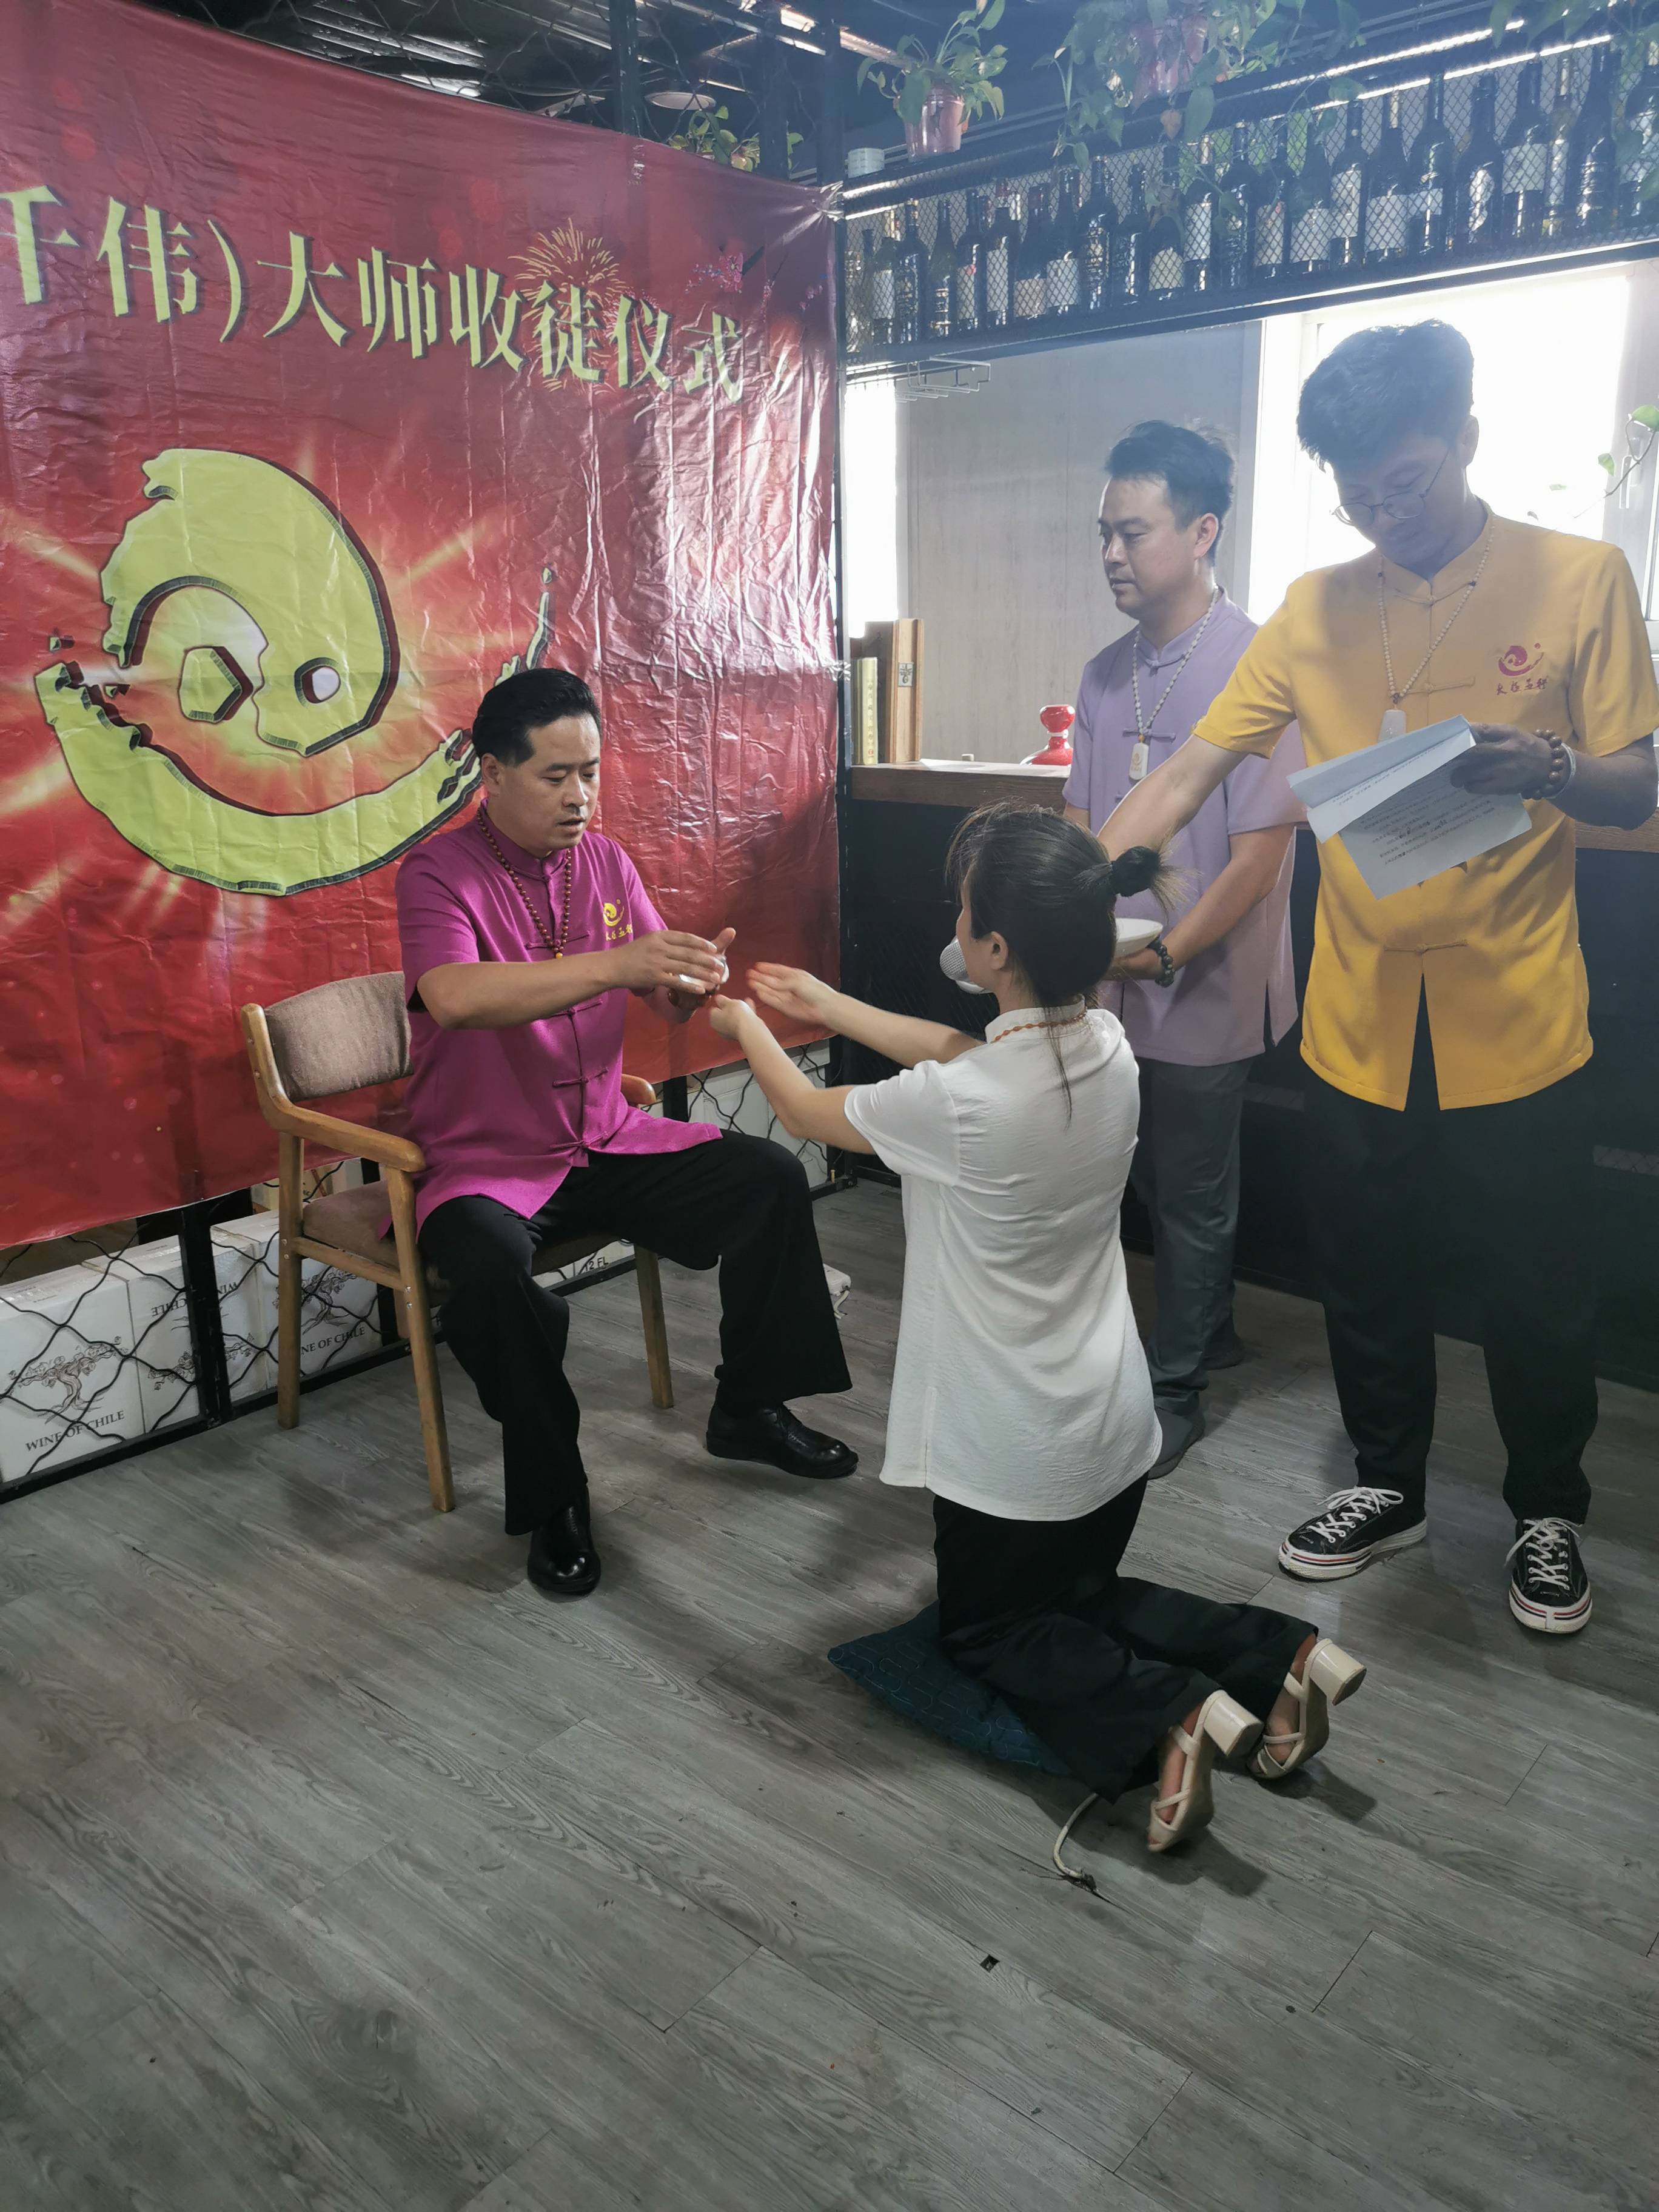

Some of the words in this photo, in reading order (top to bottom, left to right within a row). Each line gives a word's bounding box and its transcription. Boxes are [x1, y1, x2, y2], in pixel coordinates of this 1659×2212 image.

[318, 1337, 333, 1349] OF
[25, 1432, 62, 1452] WINE
[65, 1424, 84, 1438] OF
